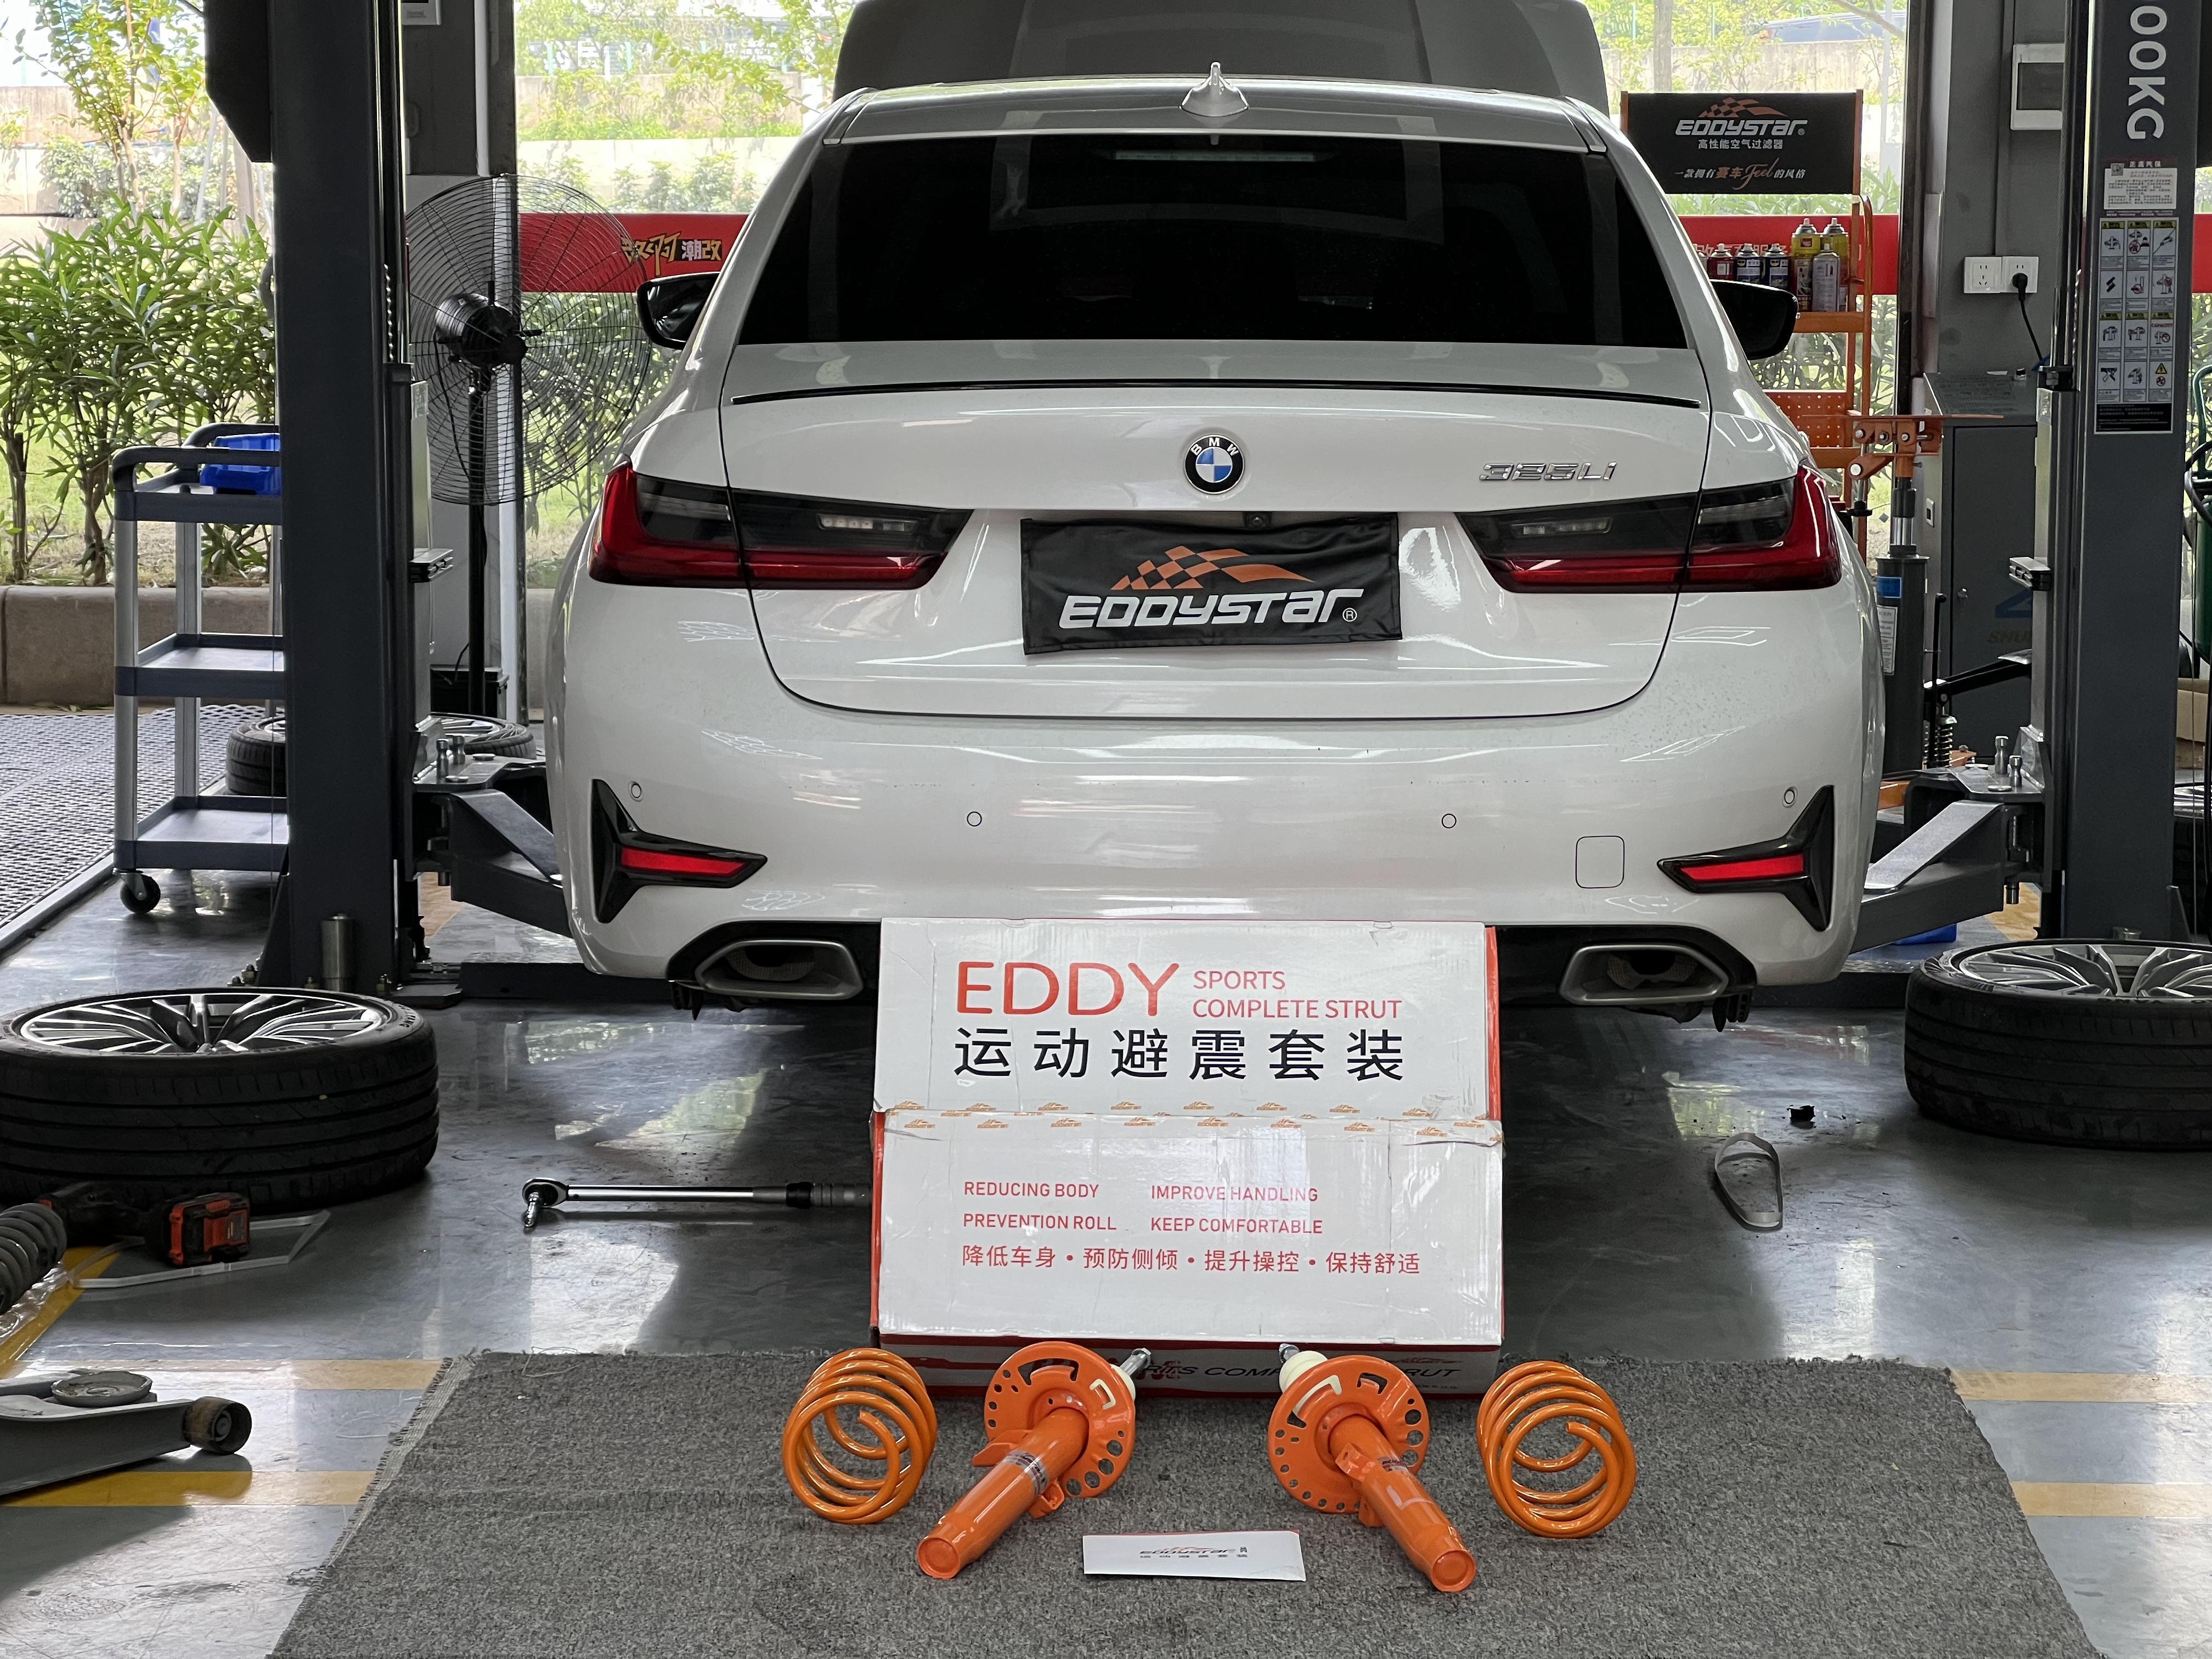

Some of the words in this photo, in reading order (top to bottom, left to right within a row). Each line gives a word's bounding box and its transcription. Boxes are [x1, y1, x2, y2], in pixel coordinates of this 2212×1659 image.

[1698, 139, 1783, 149] 高性能空气过滤器
[1190, 437, 1239, 456] BMW
[957, 961, 1179, 1017] EDDY
[1194, 970, 1285, 990] SPORTS
[1193, 998, 1318, 1018] COMPLETE
[1325, 1000, 1402, 1019] STRUT
[954, 1028, 1403, 1081] 运动避震套装
[964, 1181, 1051, 1198] REDUCING
[1054, 1183, 1099, 1199] BODY
[1152, 1185, 1226, 1201] IMPROVE
[1231, 1187, 1319, 1203] HANDLING
[963, 1213, 1070, 1230] PREVENTION
[1073, 1215, 1117, 1231] ROLL
[1151, 1217, 1195, 1232] KEEP
[1199, 1217, 1323, 1235] COMFORTABLE
[1401, 1368, 1462, 1378] RUT
